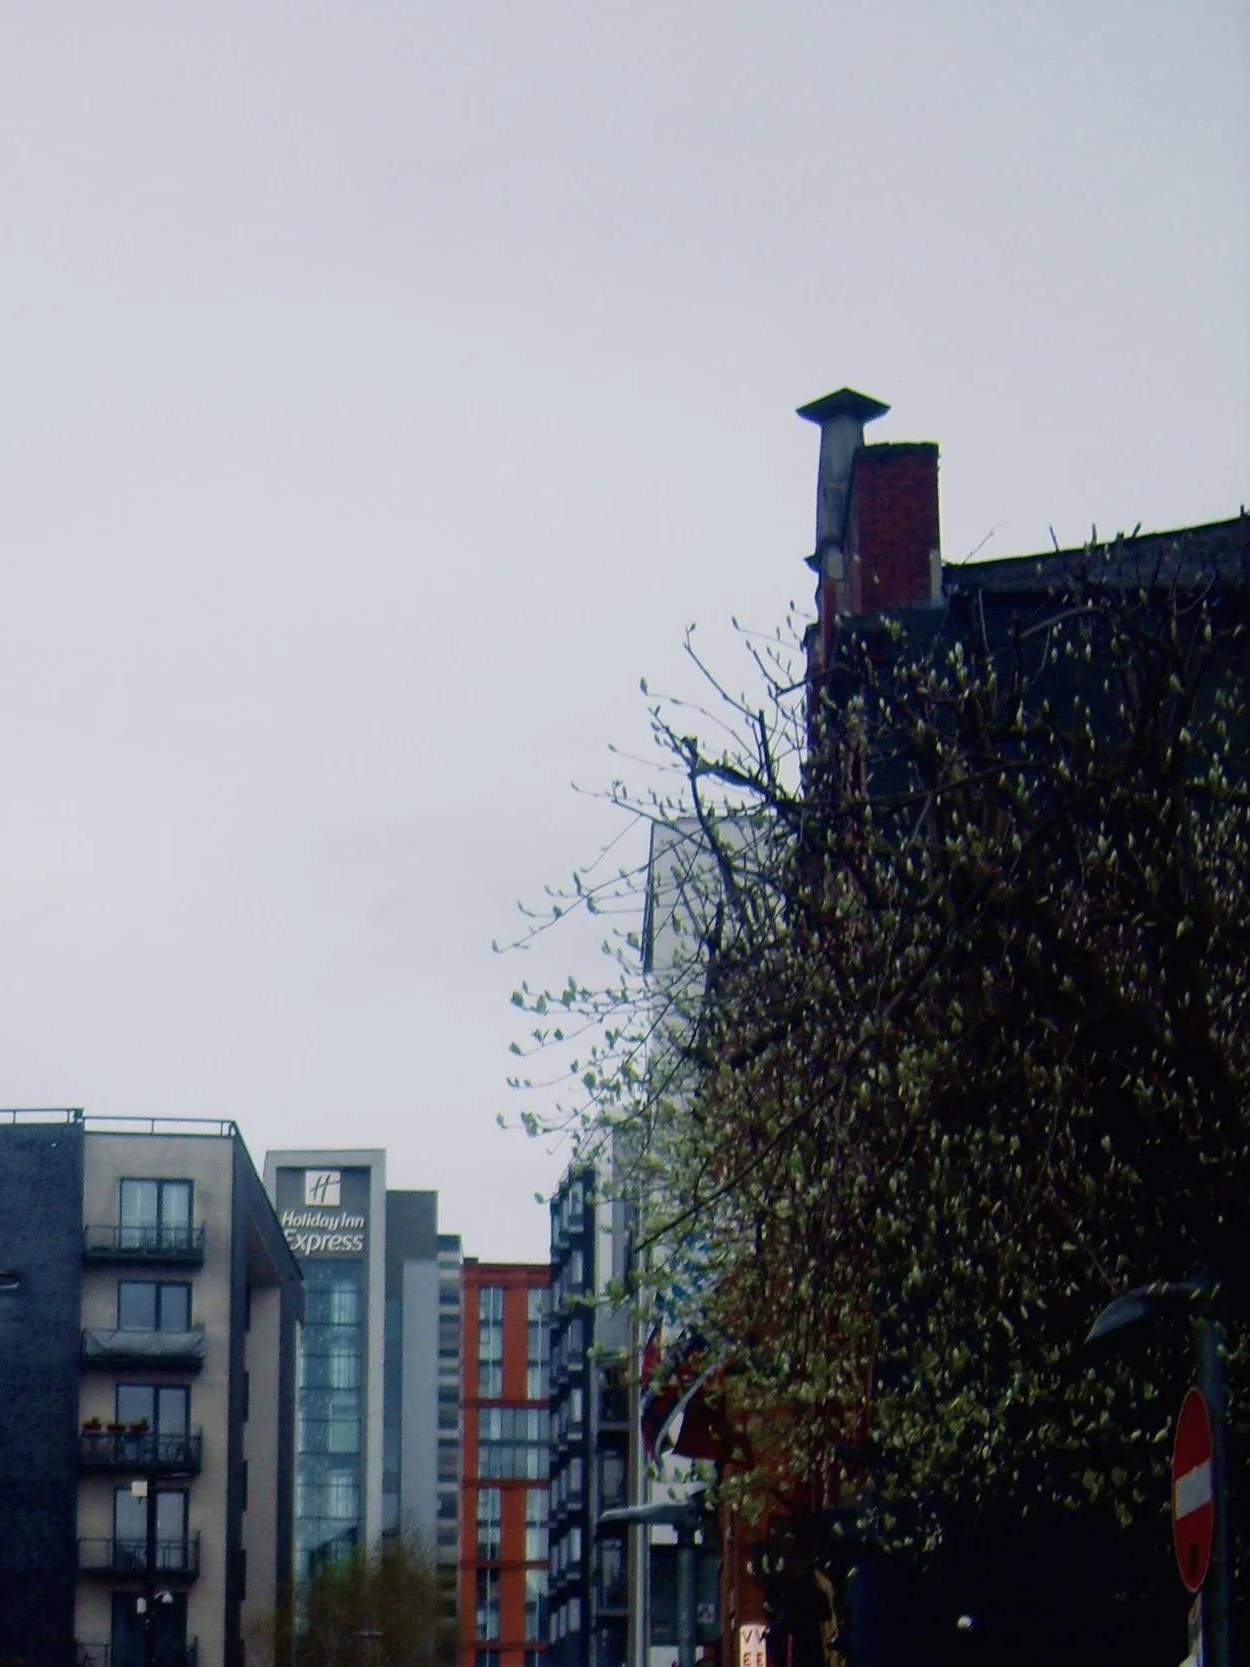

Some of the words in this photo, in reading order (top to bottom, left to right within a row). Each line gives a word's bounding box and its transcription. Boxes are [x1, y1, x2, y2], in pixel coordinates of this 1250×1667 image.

[282, 1210, 340, 1231] Holiday
[340, 1211, 366, 1228] Inn
[284, 1228, 365, 1256] Express
